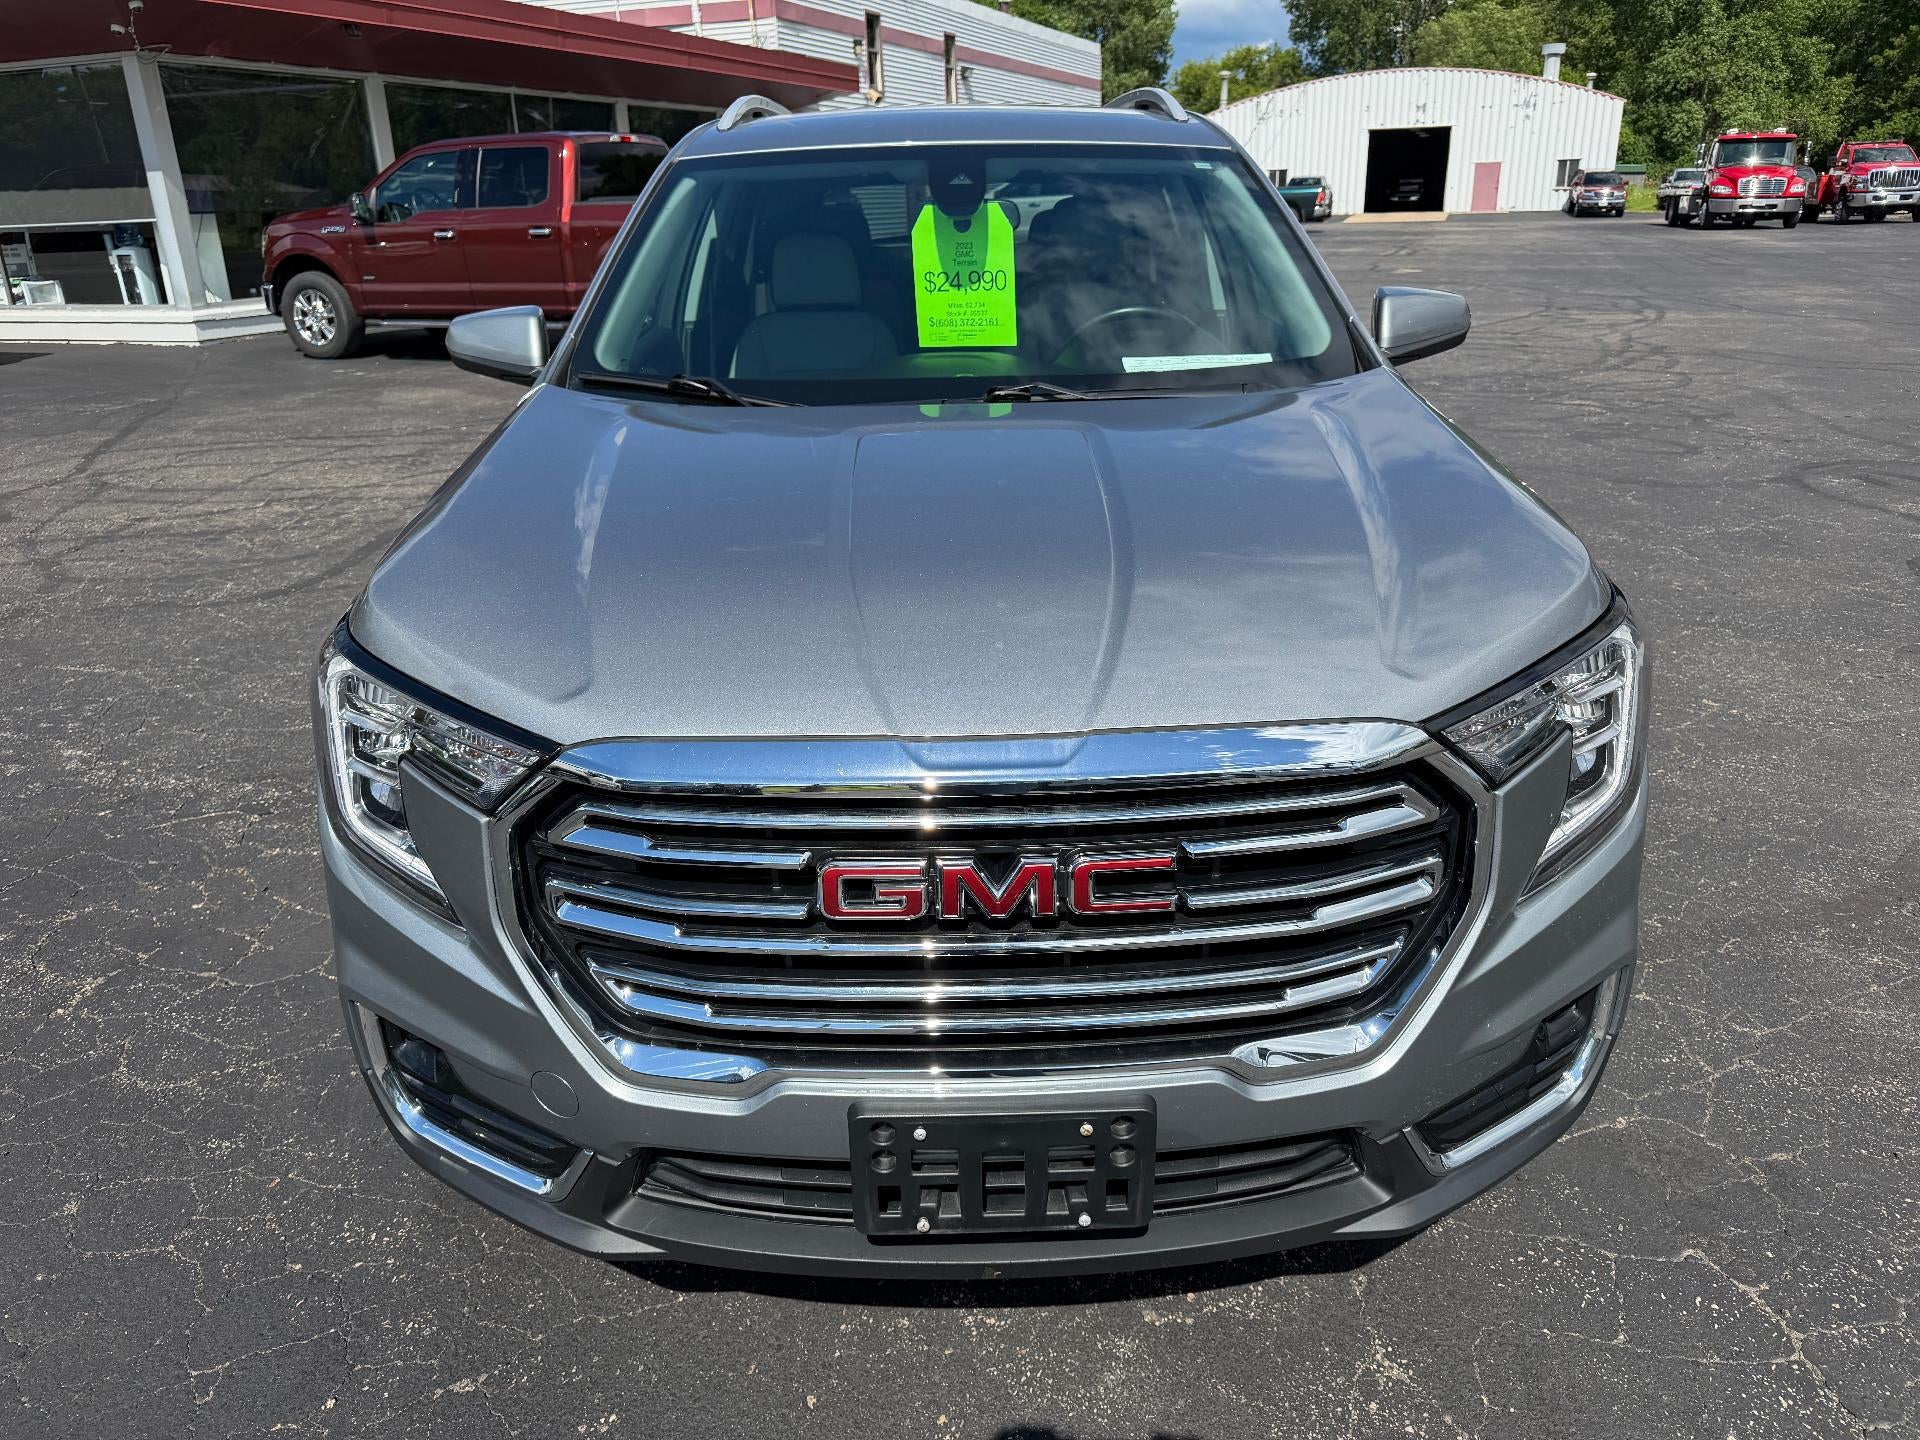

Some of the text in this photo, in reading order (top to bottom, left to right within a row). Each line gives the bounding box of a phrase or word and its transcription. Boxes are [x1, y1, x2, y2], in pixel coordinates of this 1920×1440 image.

[955, 250, 974, 258] GMC
[952, 258, 978, 267] Terrain
[924, 269, 1007, 295] $24,990
[959, 317, 999, 327] 372-2161
[817, 851, 1177, 922] GMC
